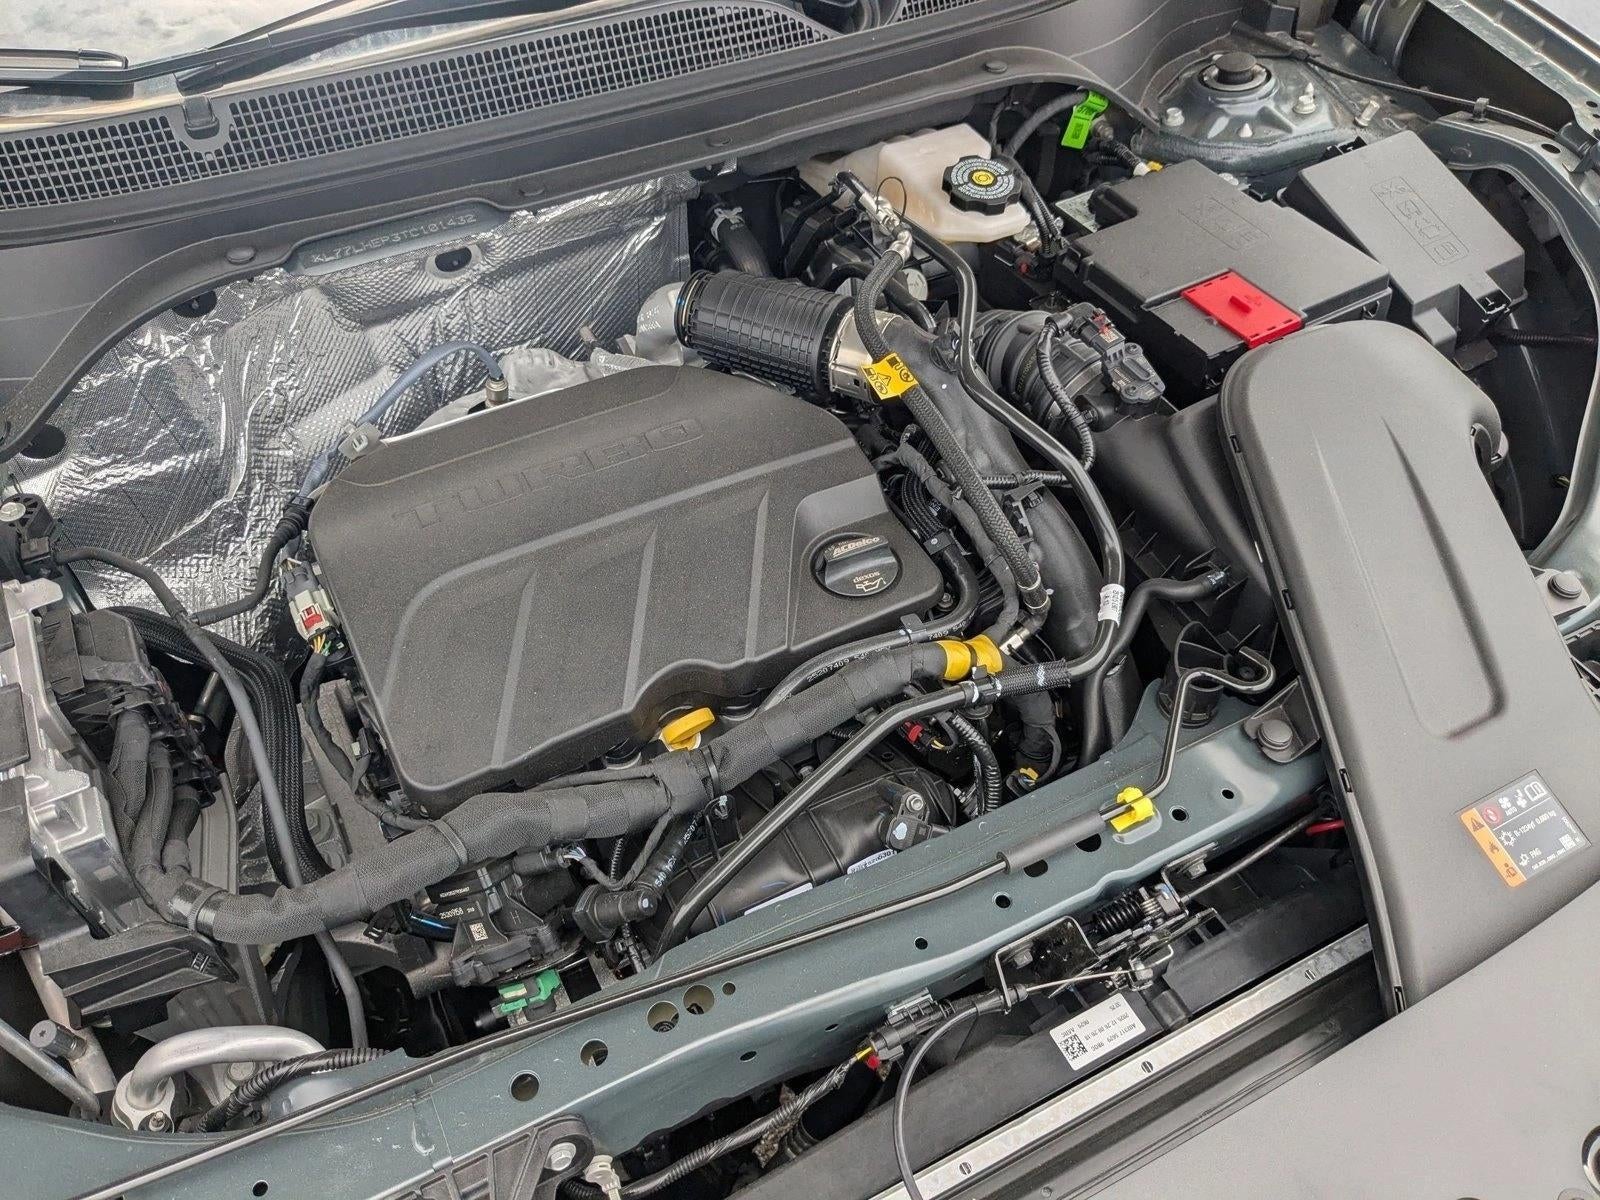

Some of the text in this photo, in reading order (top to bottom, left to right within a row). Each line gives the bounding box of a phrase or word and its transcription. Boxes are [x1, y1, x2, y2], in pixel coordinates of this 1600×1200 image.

[311, 214, 477, 263] KL77LHEP3TC101432
[392, 419, 704, 529] TURBO
[833, 537, 880, 557] ACDelco
[853, 571, 880, 583] dexos
